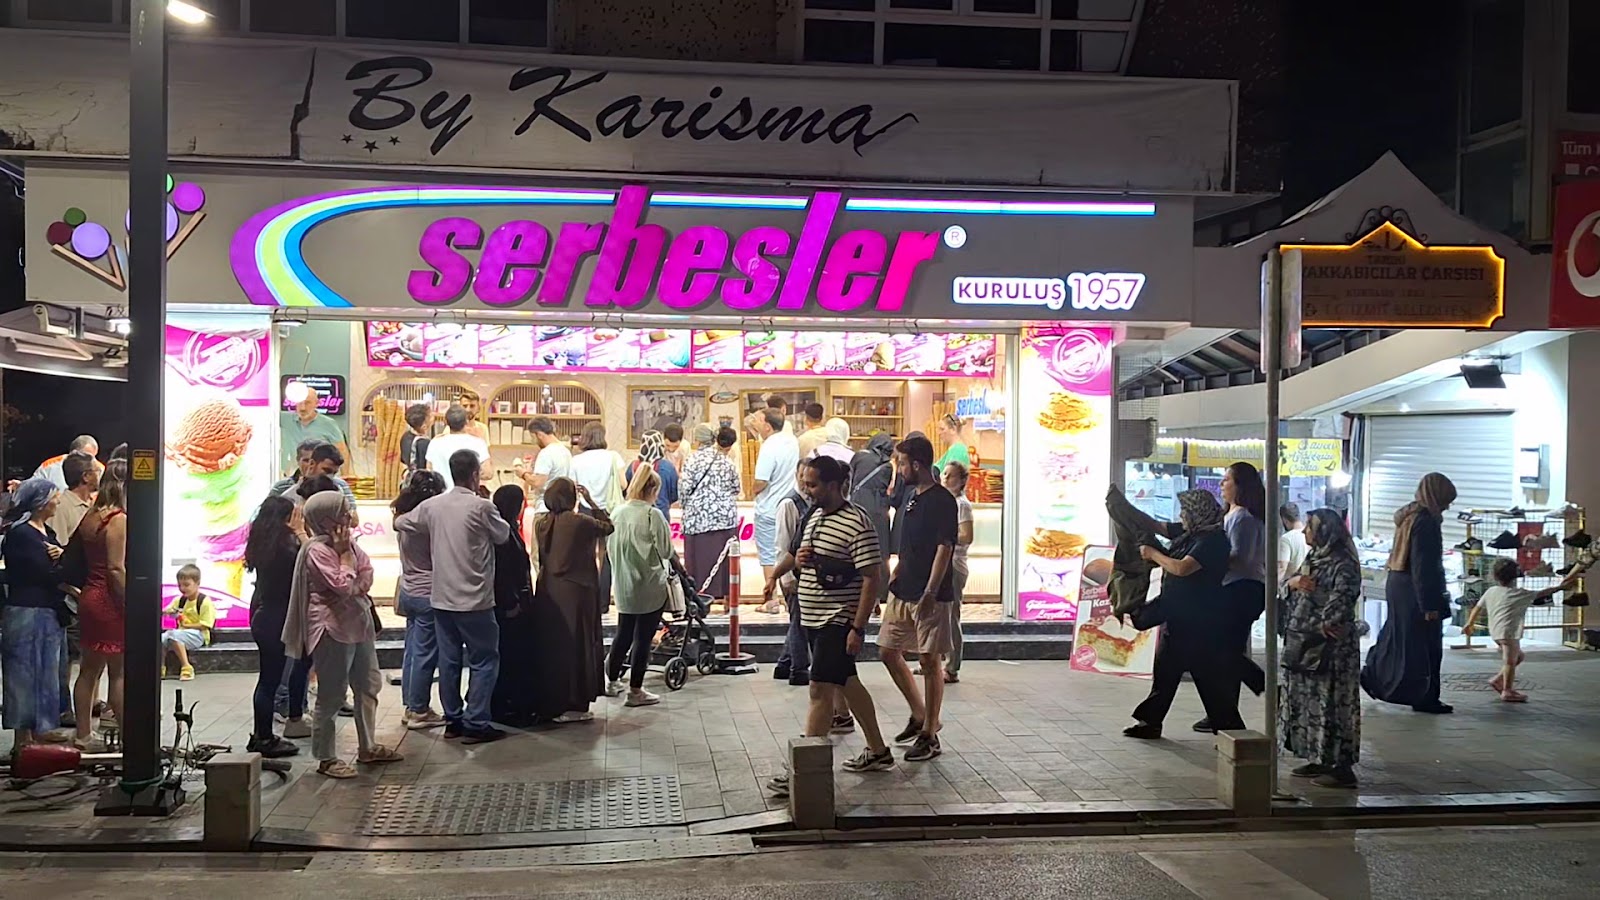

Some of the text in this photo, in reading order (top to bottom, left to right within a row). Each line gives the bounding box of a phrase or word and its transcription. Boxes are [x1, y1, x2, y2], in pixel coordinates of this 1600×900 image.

[345, 56, 919, 156] By Karisma
[407, 185, 940, 312] serbesler
[957, 277, 1140, 305] KURULUŞ 1957
